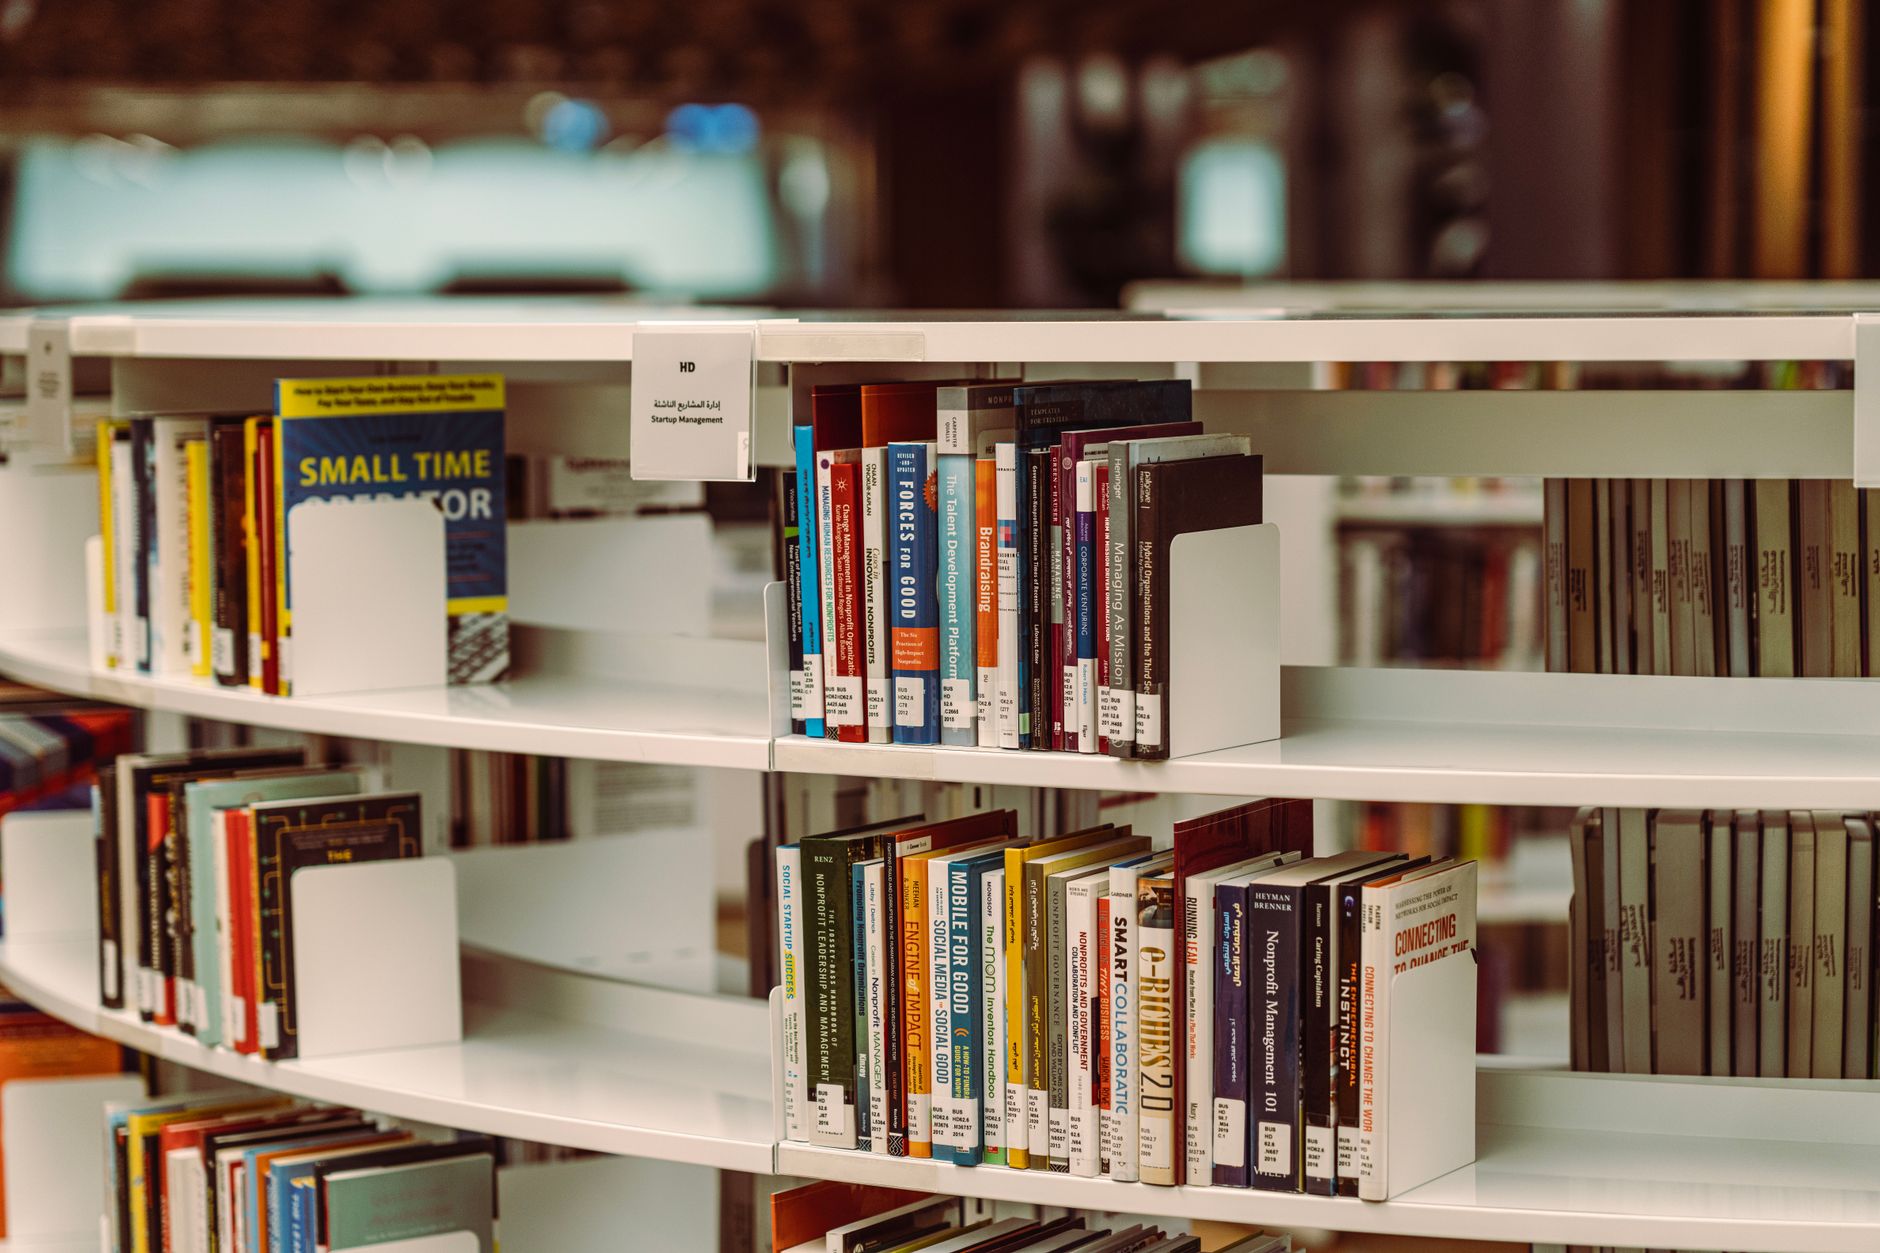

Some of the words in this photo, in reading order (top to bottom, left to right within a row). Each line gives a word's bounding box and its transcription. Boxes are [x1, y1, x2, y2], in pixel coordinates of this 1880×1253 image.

[680, 361, 696, 373] HD
[651, 415, 677, 424] Startup
[678, 416, 723, 425] Management
[654, 400, 676, 408] الناشئة
[677, 401, 705, 412] المشاريع
[706, 400, 721, 411] إدارة
[300, 453, 408, 487] SMALL
[413, 449, 491, 480] TIME
[947, 475, 957, 496] The
[1113, 458, 1122, 500] Heninger
[1143, 471, 1151, 503] palgrave
[822, 485, 830, 521] MANAGING
[842, 504, 850, 533] Change
[899, 481, 915, 542] FORCES
[947, 499, 957, 537] Talent
[823, 522, 831, 547] HUMAN
[824, 548, 833, 586] RESOURCES
[843, 534, 851, 584] Management
[900, 548, 911, 568] FOR
[979, 527, 994, 614] Brandraising
[1143, 541, 1152, 568] Hybrid
[825, 587, 833, 601] FOR
[946, 540, 959, 624] Development
[1113, 542, 1125, 611] Managing
[845, 593, 854, 631] Nonprofit
[900, 576, 916, 619] GOOD
[1143, 570, 1152, 625] Organizations
[825, 602, 834, 642] NONPROFITS
[867, 606, 875, 665] NONPROFITS
[1115, 614, 1125, 631] As
[1144, 626, 1152, 643] and
[949, 627, 960, 680] Platform
[1115, 635, 1125, 685] Mission
[1144, 643, 1152, 656] the
[1144, 657, 1152, 679] Third
[782, 865, 791, 900] SOCIAL
[816, 873, 826, 927] NONPROFIT
[856, 880, 864, 922] Promoting
[951, 871, 968, 930] MOBILE
[1255, 892, 1291, 902] HEYMAN
[1394, 894, 1423, 909] HARNESSING
[1423, 892, 1432, 900] THE
[1052, 891, 1060, 951] NONPROFIT
[1186, 897, 1198, 939] RUNNING
[1232, 902, 1243, 918] في
[1254, 902, 1292, 911] BRENNER
[1394, 907, 1419, 920] NETWORKS
[1418, 903, 1427, 912] FOR
[1442, 893, 1458, 905] IMPACT
[784, 904, 792, 950] STARTUP
[857, 923, 865, 960] Nonprofit
[934, 920, 946, 961] SOCIAL
[1232, 919, 1240, 954] منظمات
[1394, 913, 1457, 957] CONNECTING
[818, 930, 827, 990] LEADERSHIP
[905, 921, 920, 980] ENGINE
[952, 935, 968, 966] FOR
[985, 946, 996, 993] mom
[1079, 931, 1088, 989] NONPROFITS
[1187, 941, 1198, 965] LEAN
[1223, 941, 1231, 975] التنظيمي
[1263, 930, 1279, 996] Nonprofit
[785, 953, 794, 1000] SUCCESS
[858, 962, 866, 1016] Organizations
[935, 963, 948, 1001] MEDIA
[1100, 967, 1108, 996] TINY
[1232, 955, 1242, 987] الأعمال
[1314, 966, 1322, 1008] Capitalism
[819, 994, 828, 1012] AND
[871, 977, 881, 1027] Nonprofit
[953, 972, 969, 1014] GOOD
[1080, 990, 1088, 1008] AND
[1364, 966, 1375, 1030] CONNECTING
[907, 992, 922, 1051] IMPACT
[935, 1009, 948, 1050] SOCIAL
[986, 998, 994, 1046] Inventors
[1100, 998, 1109, 1041] BUSINESS
[1340, 978, 1350, 1070] INSTINCT
[1364, 1031, 1373, 1042] TO
[820, 1016, 829, 1082] MANAGEMENT
[1080, 1010, 1088, 1072] GOVERNMENT
[1262, 1000, 1278, 1085] Management
[936, 1052, 949, 1085] GOOD
[1364, 1045, 1374, 1084] CHANGE
[1140, 1071, 1173, 1112] 2.0
[1265, 1091, 1277, 1112] 101
[1363, 1087, 1373, 1106] THE
